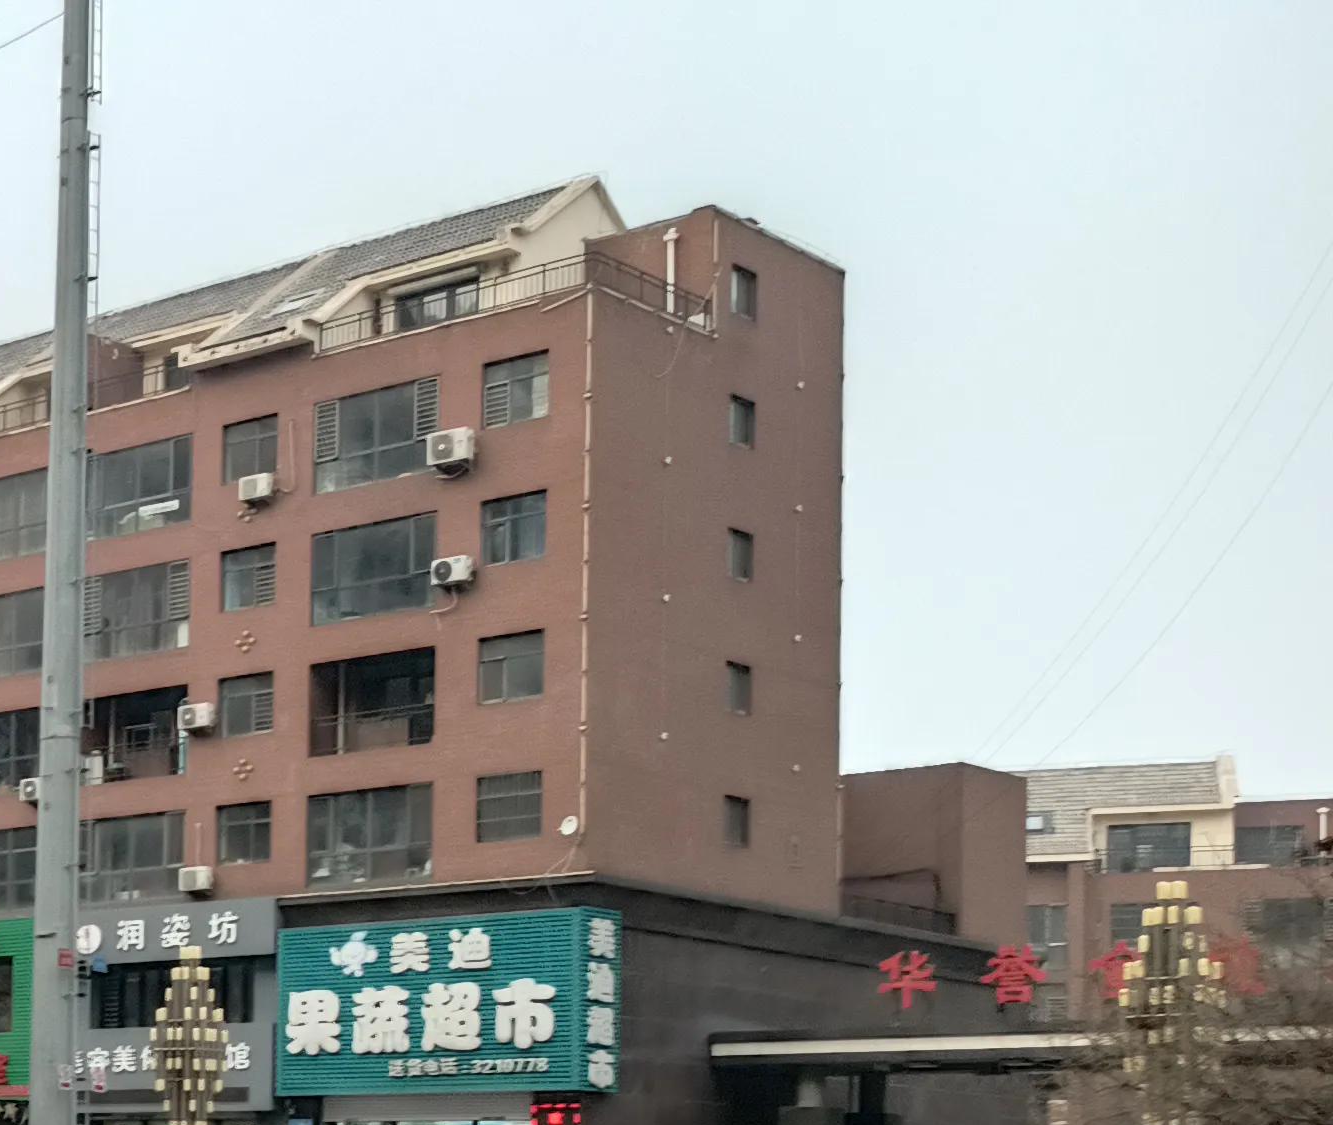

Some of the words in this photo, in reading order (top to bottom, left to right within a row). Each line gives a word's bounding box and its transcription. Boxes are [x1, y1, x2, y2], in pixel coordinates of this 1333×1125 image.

[116, 911, 240, 951] 润姿坊
[389, 926, 492, 974] 美迪
[284, 977, 557, 1056] 果蔬超市
[586, 917, 617, 1089] 美迪超市
